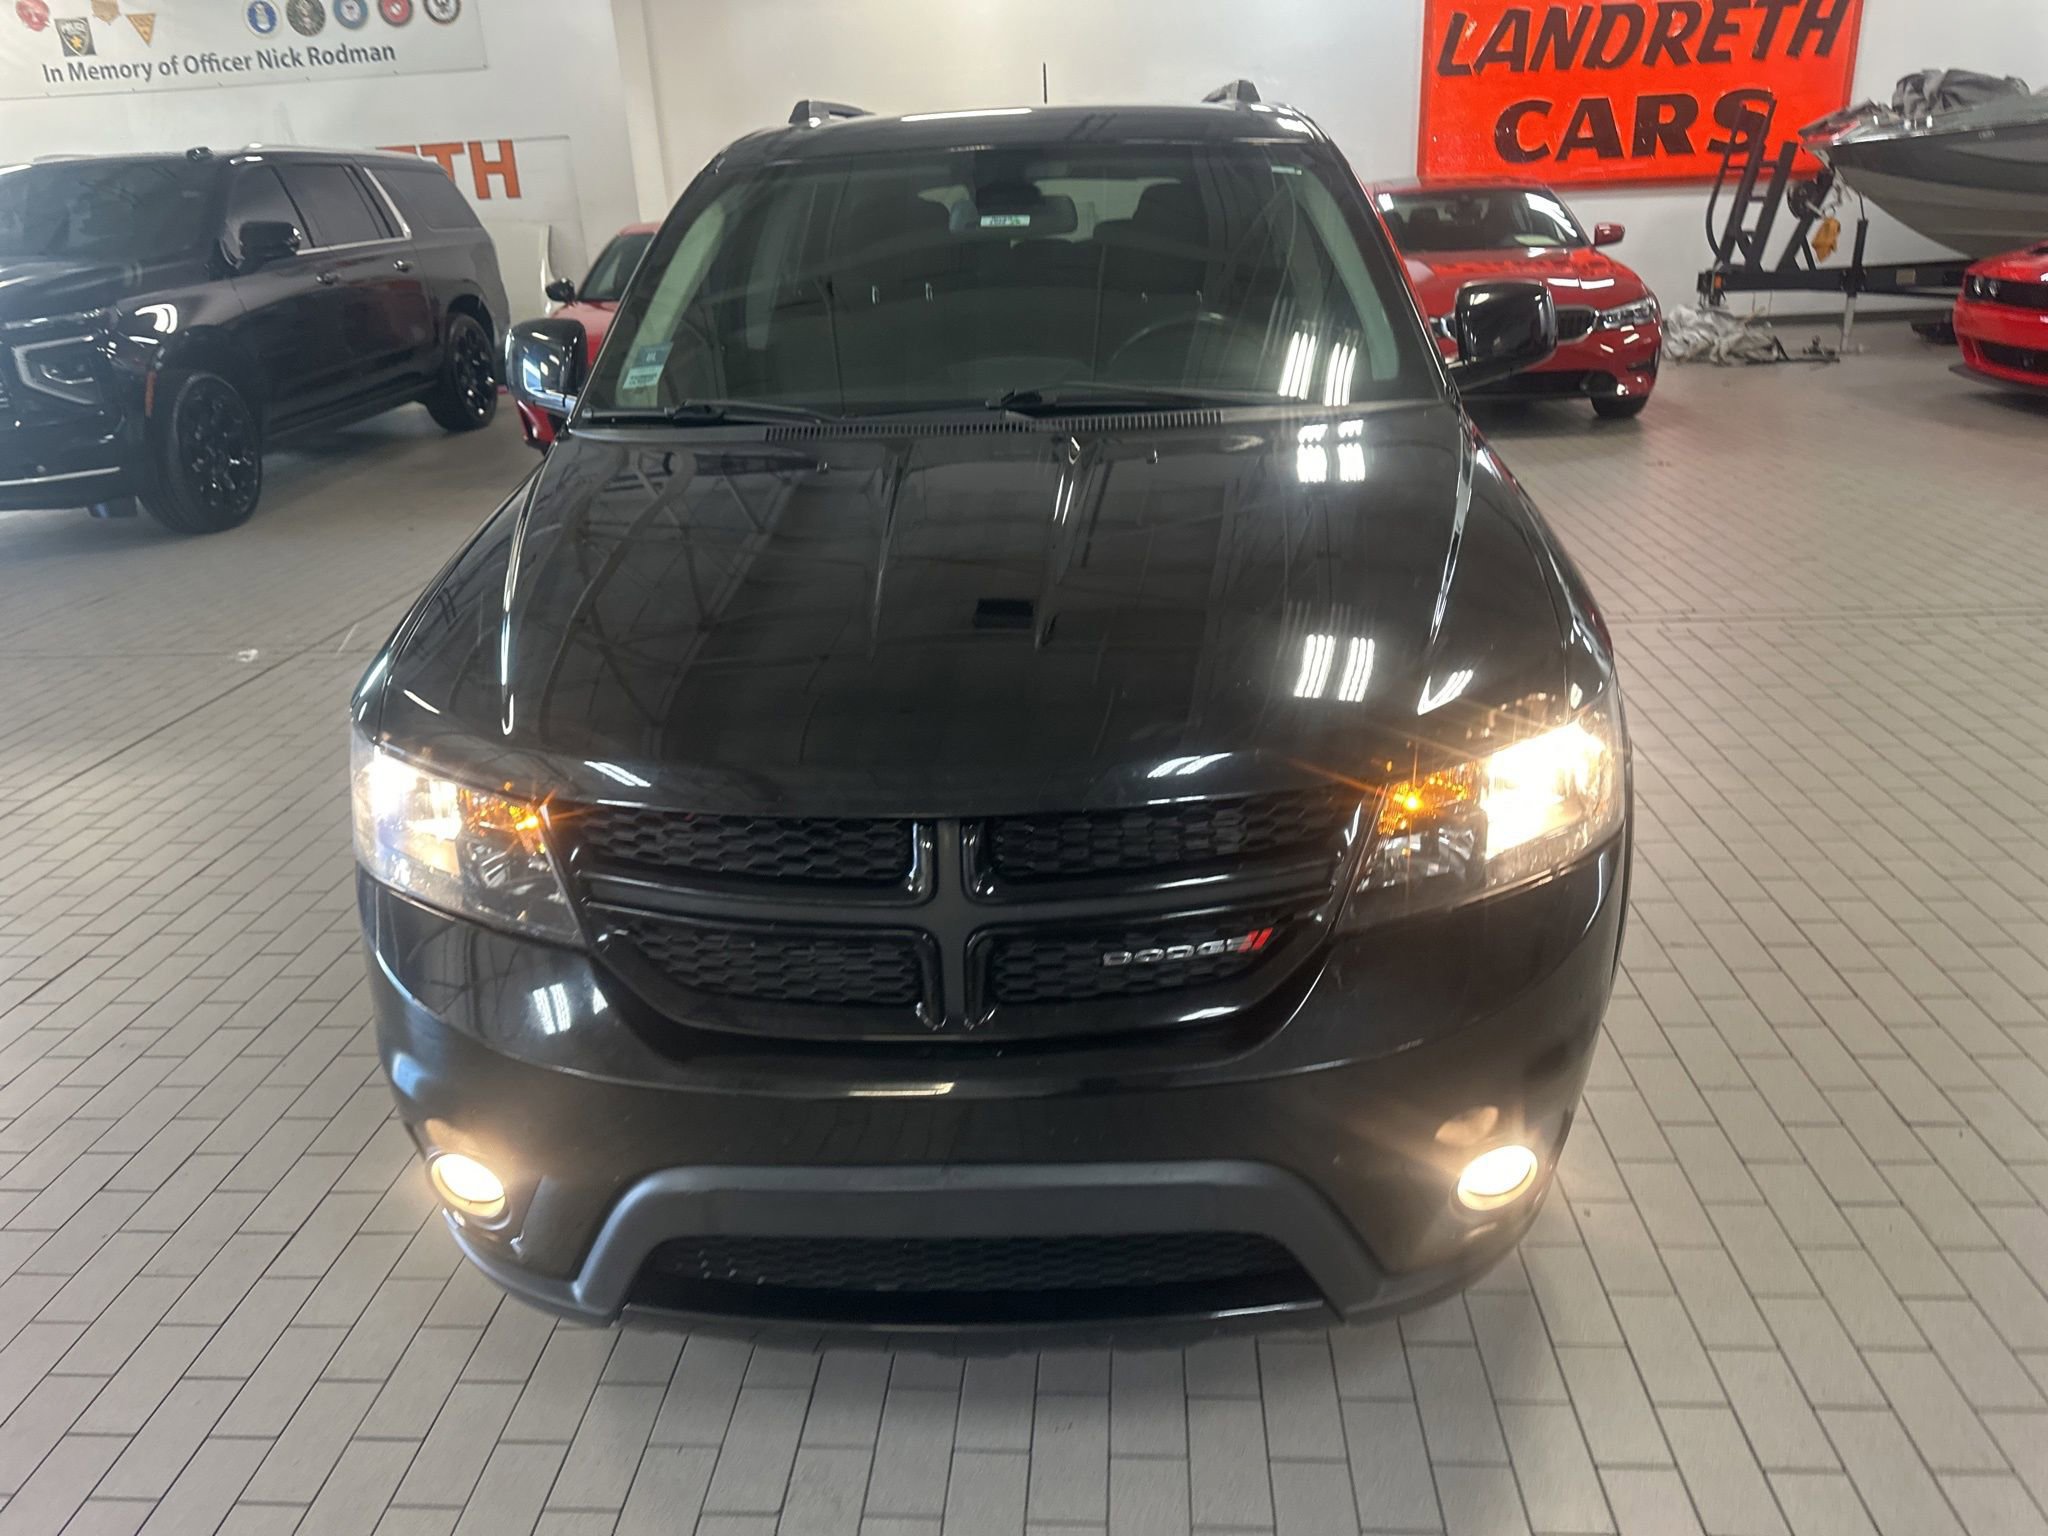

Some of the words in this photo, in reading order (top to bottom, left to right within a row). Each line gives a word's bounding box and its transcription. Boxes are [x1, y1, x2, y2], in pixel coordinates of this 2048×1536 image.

[42, 64, 64, 83] In
[68, 60, 152, 82] Memory
[159, 55, 179, 76] of
[184, 51, 252, 74] Officer
[257, 45, 305, 70] Nick
[307, 43, 397, 67] Rodman
[1437, 0, 1849, 76] LANDRETH
[1494, 88, 1774, 163] CARS
[1103, 936, 1253, 966] DODGE
